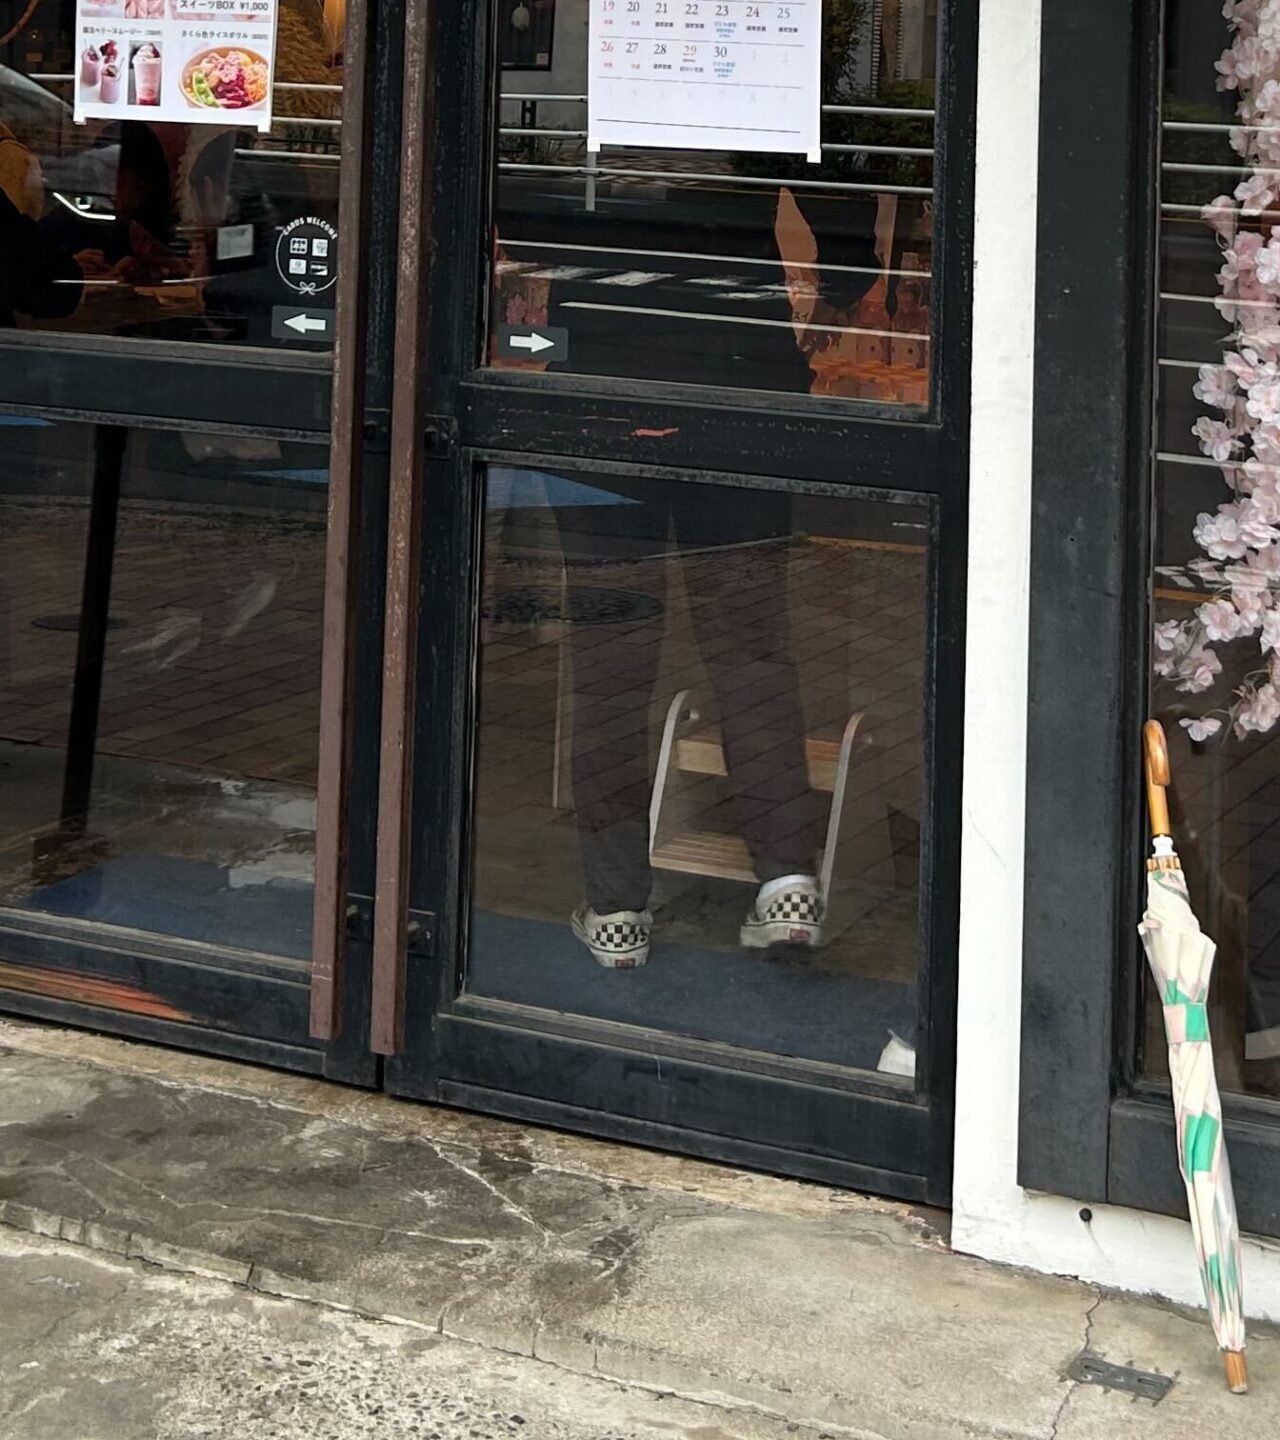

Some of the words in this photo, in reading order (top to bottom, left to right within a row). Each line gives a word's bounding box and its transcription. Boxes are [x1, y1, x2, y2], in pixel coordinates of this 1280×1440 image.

[239, 1, 269, 12] ¥1,000
[602, 0, 615, 12] 19
[626, 1, 640, 12] 20
[655, 2, 668, 14] 21
[685, 4, 699, 15] 22
[715, 5, 729, 17] 23
[745, 6, 760, 18] 24
[776, 8, 791, 19] 25
[600, 41, 614, 52] 26
[625, 42, 639, 54] 27
[653, 44, 667, 55] 28
[682, 45, 697, 56] 29
[713, 46, 728, 58] 30
[282, 216, 305, 235] CARDS
